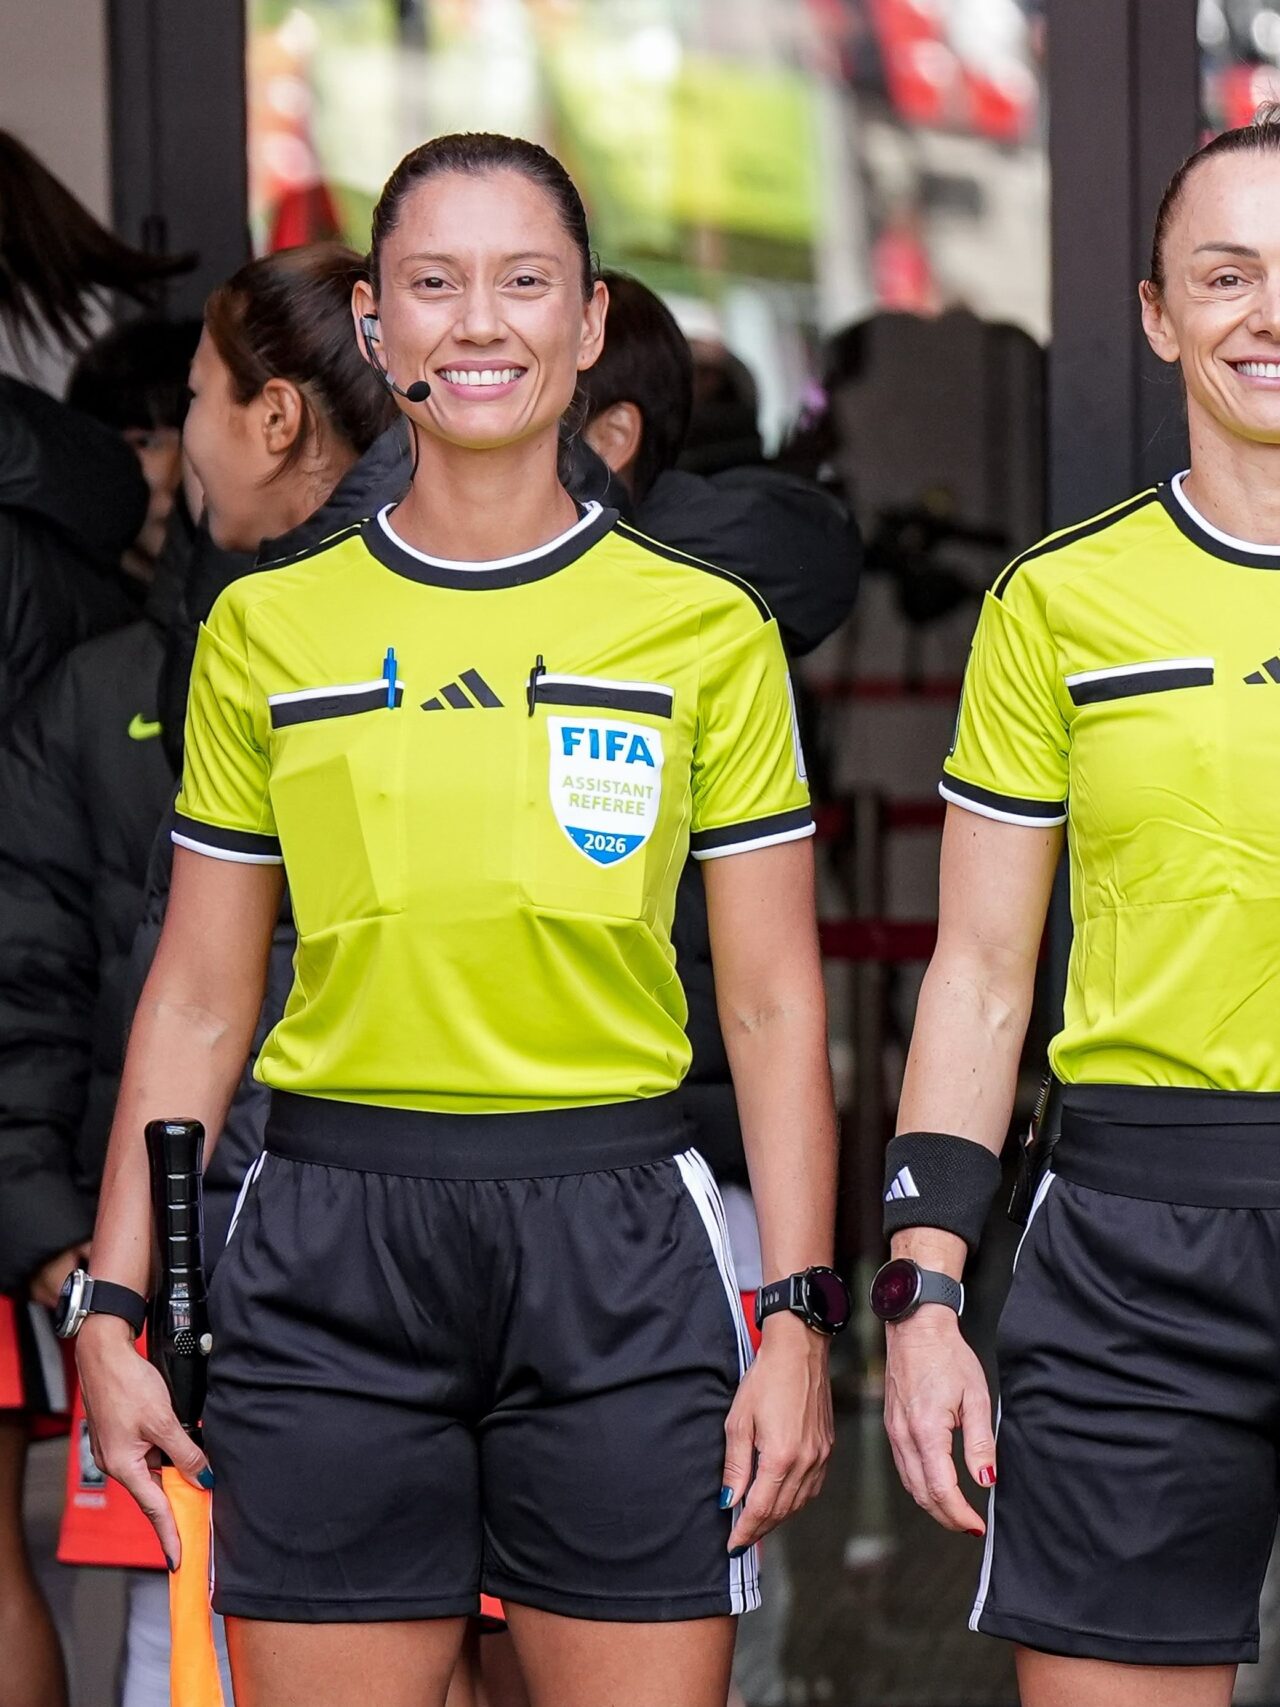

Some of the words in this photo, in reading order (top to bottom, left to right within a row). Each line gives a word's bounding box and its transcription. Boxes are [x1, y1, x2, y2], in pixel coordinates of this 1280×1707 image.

[561, 727, 655, 768] FIFA
[561, 775, 654, 800] ASSISTANT
[568, 792, 646, 816] REFEREE
[583, 833, 627, 853] 2026
